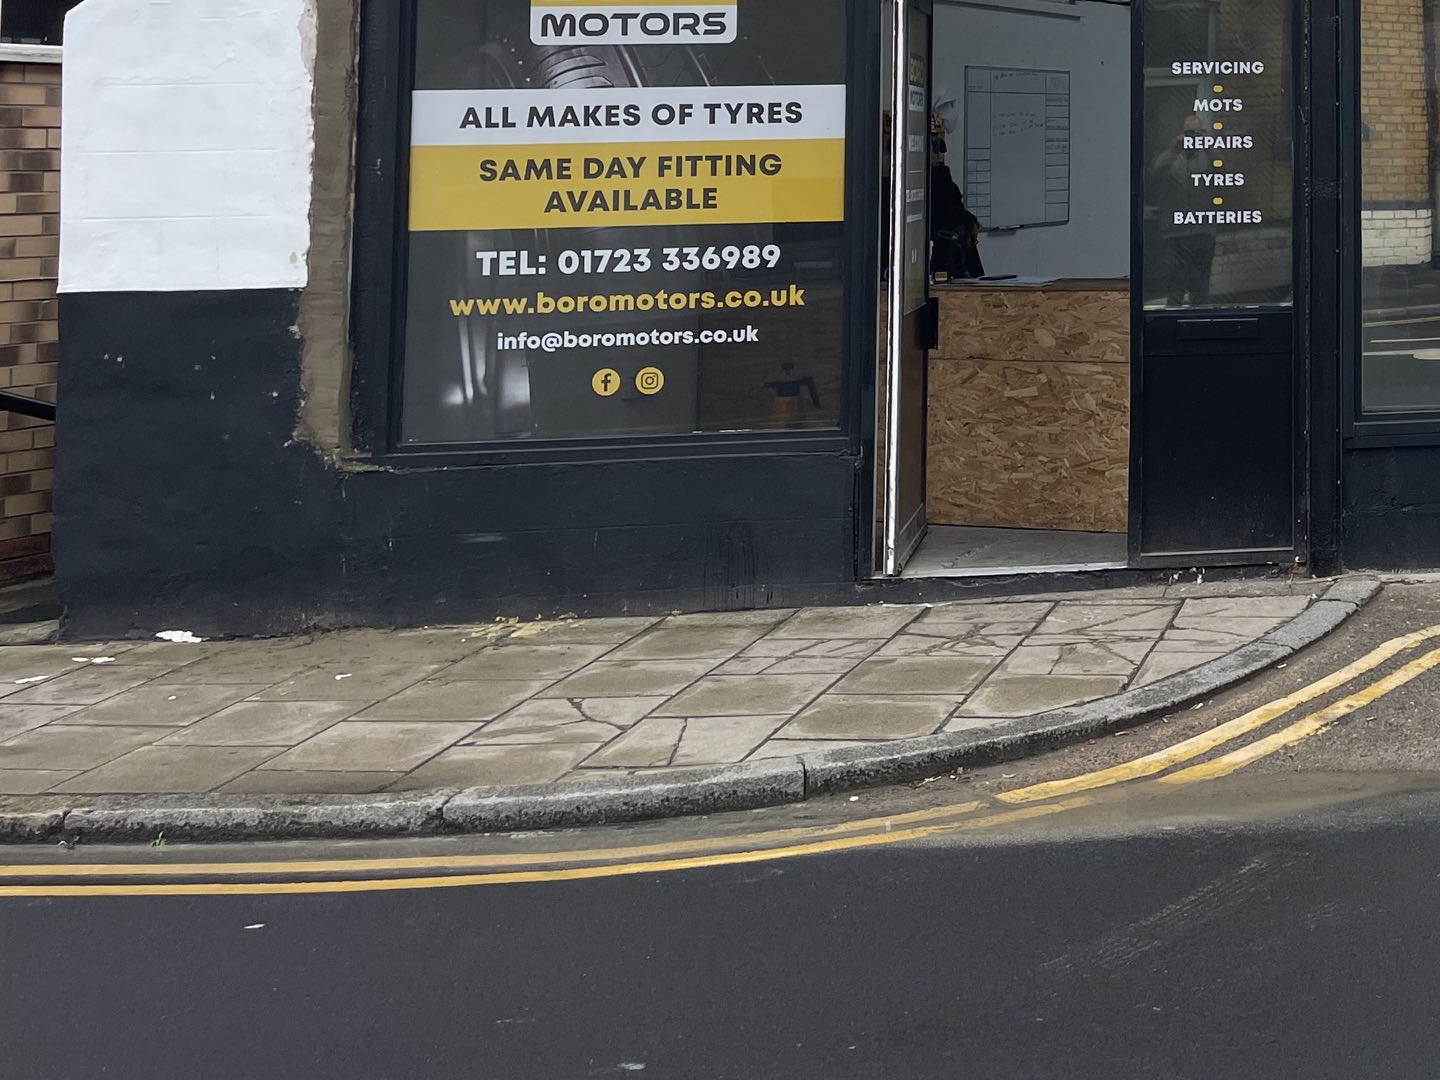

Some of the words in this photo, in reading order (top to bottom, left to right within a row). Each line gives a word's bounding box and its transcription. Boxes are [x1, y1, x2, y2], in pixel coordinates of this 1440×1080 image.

[540, 13, 728, 38] MOTORS
[1171, 61, 1265, 75] SERVICING
[459, 106, 517, 130] ALL
[526, 104, 642, 129] MAKES
[651, 103, 694, 127] OF
[703, 101, 804, 126] TYRES
[1193, 99, 1244, 112] MOTS
[1183, 136, 1254, 150] REPAIRS
[479, 158, 573, 183] SAME
[583, 156, 647, 181] DAY
[658, 154, 783, 179] FITTING
[1191, 174, 1245, 187] TYRES
[544, 188, 719, 214] AVAILABLE
[1173, 210, 1263, 225] BATTERIES
[476, 251, 547, 277] TEL:
[557, 248, 652, 276] 01723
[661, 244, 782, 272] 336989
[450, 283, 805, 317] www.boromotors.co.uk
[497, 324, 760, 353] info@boromotors.co.uk
